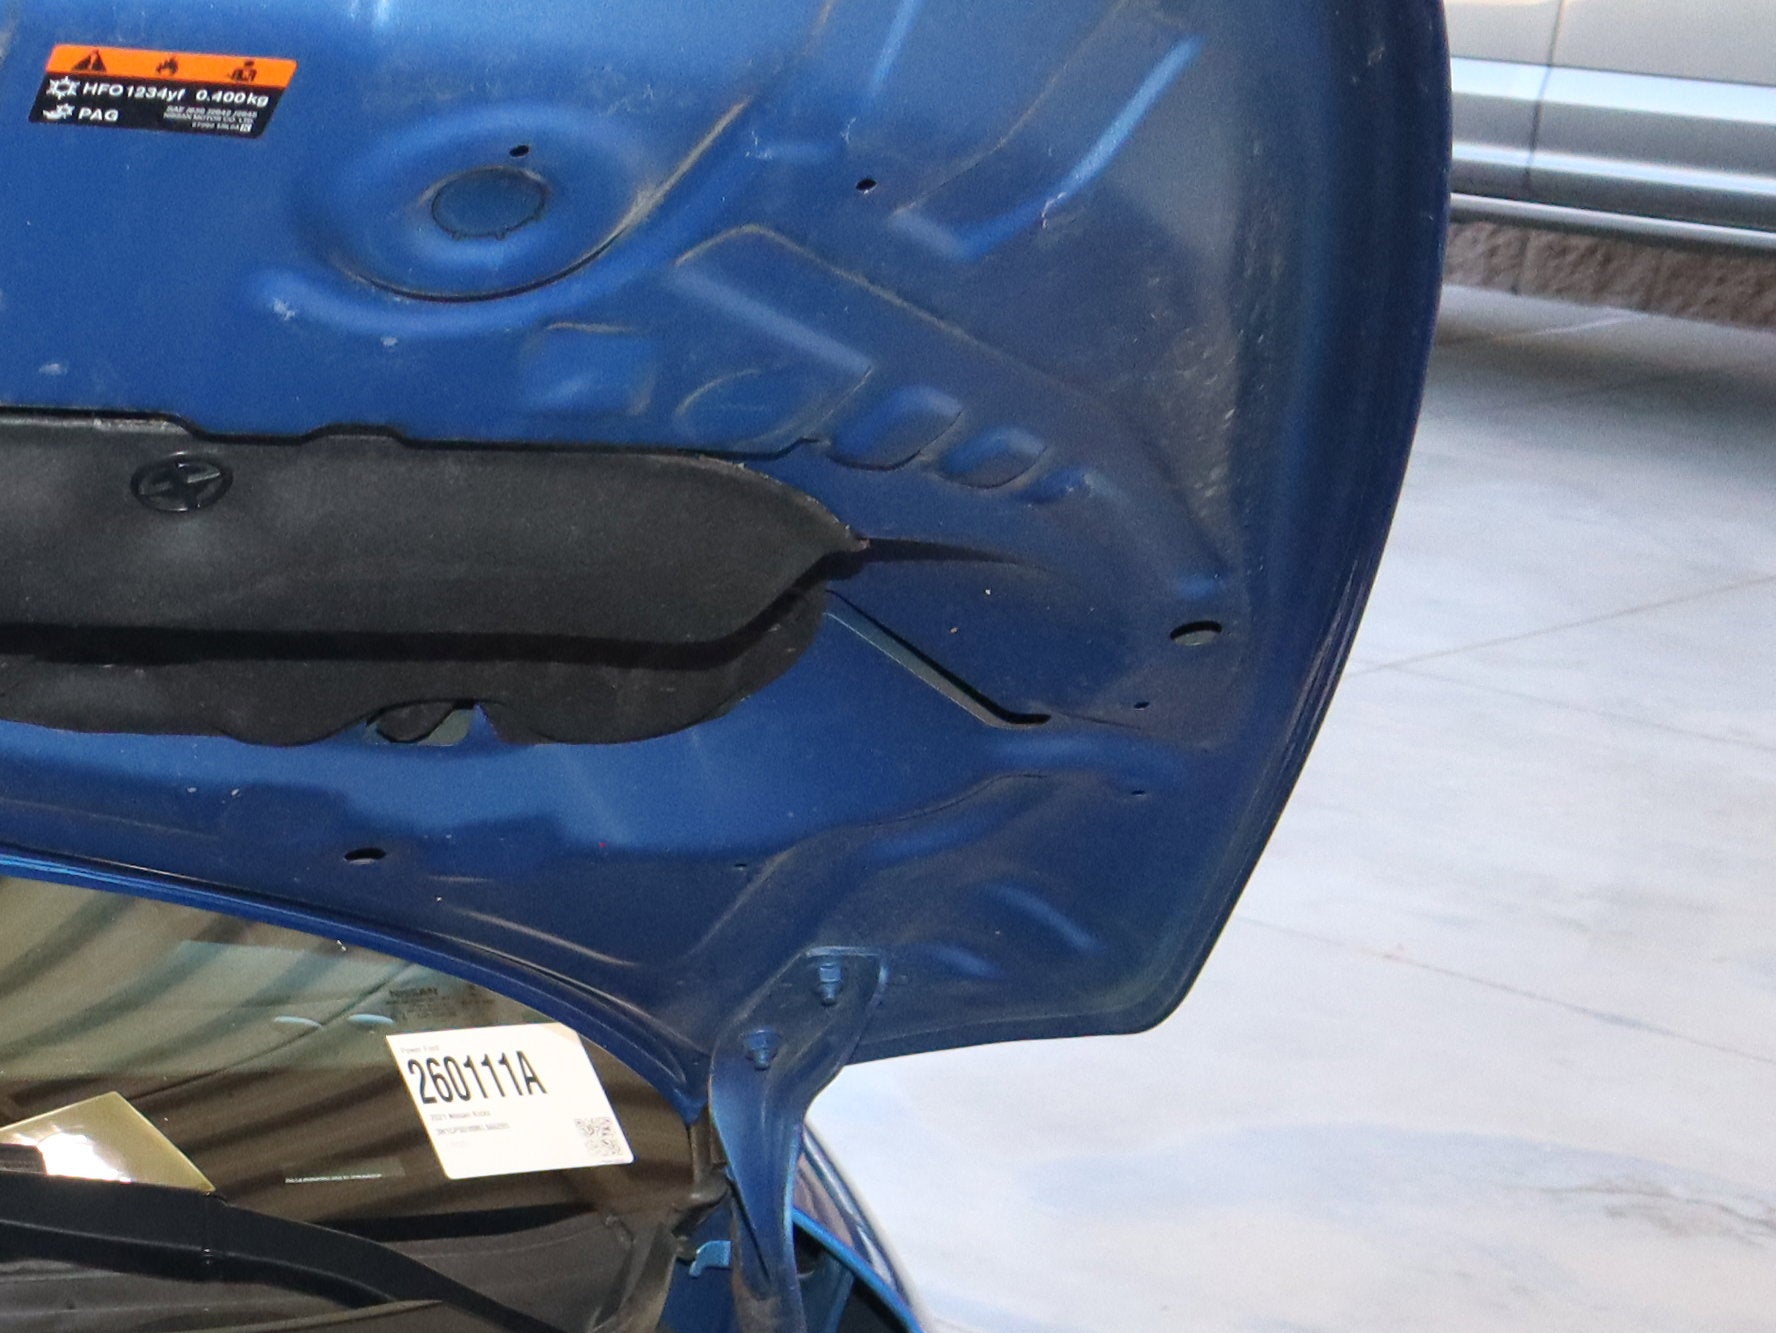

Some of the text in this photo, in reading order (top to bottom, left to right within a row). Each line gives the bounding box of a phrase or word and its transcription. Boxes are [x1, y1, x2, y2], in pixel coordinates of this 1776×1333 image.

[82, 82, 270, 108] HFO 1234yf 0.400 kg
[78, 107, 120, 122] PAG
[407, 1050, 547, 1105] 260111A
